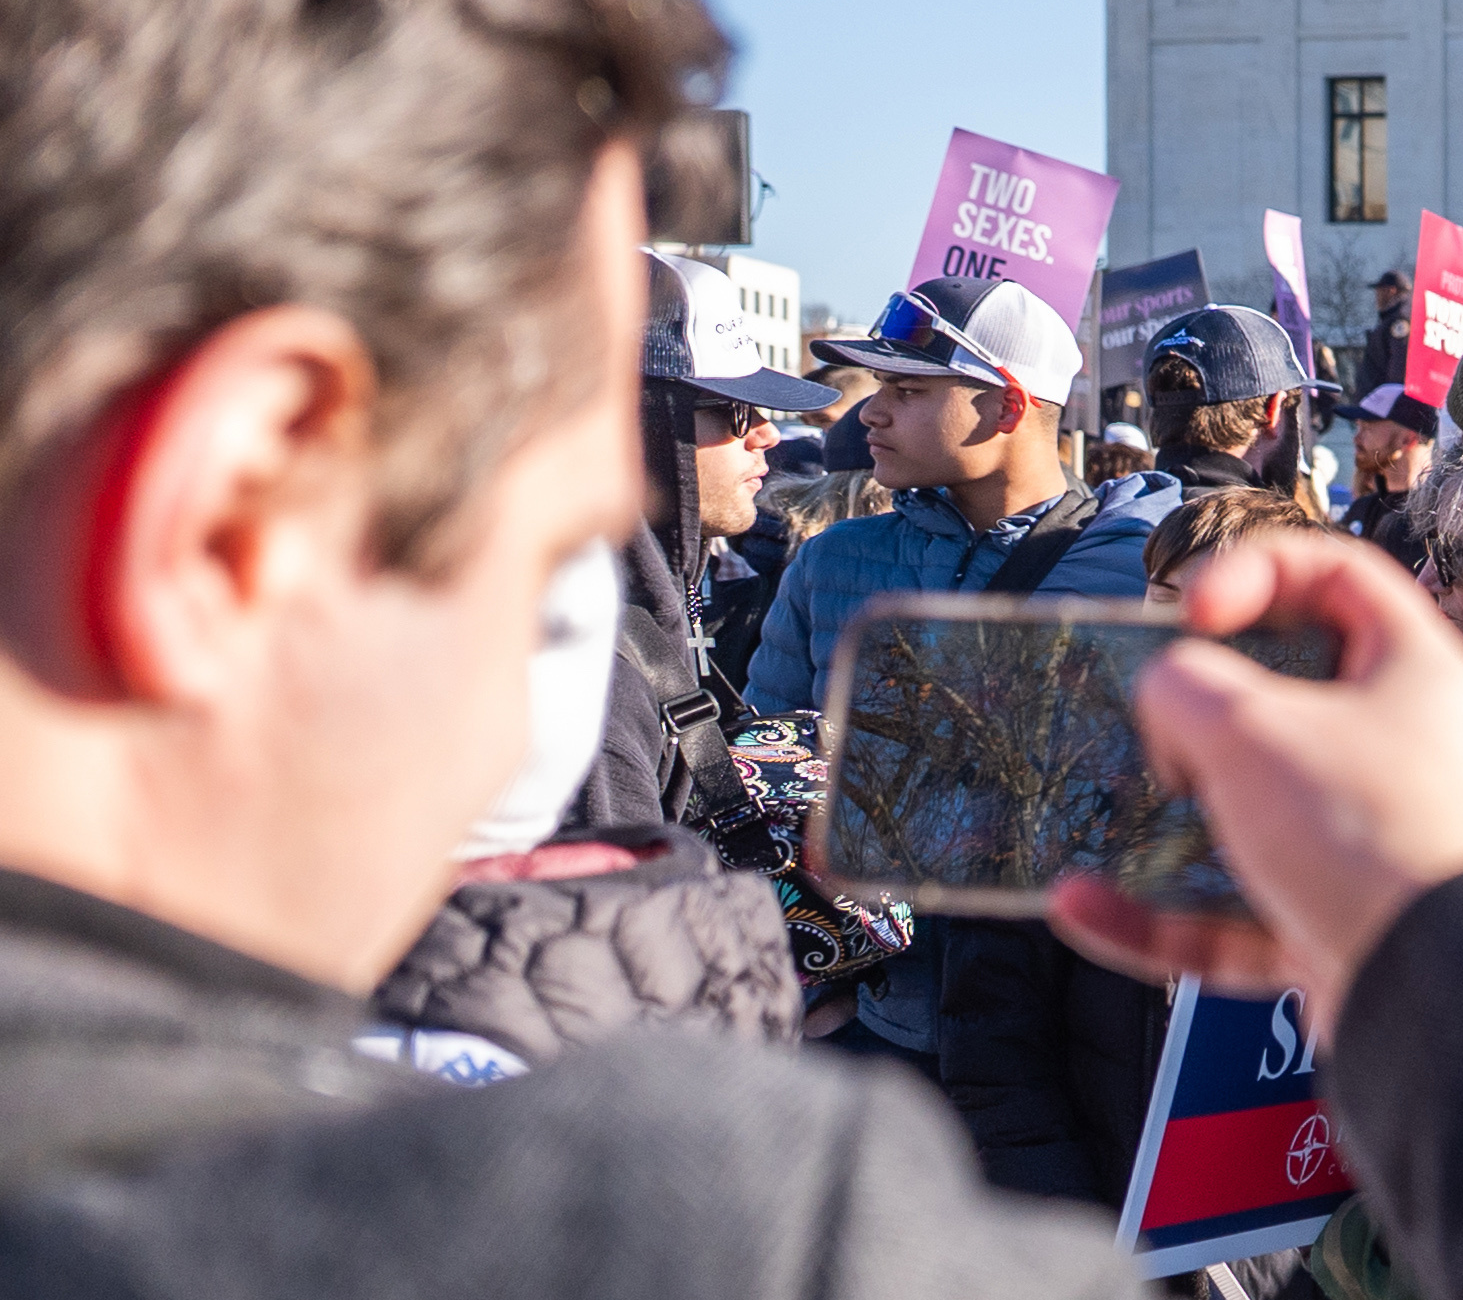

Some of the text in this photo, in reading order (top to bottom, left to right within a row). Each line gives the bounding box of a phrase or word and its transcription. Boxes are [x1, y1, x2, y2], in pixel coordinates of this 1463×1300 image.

[969, 162, 1037, 215] TWO
[952, 203, 1055, 265] SEXES.
[1136, 286, 1194, 318] sports
